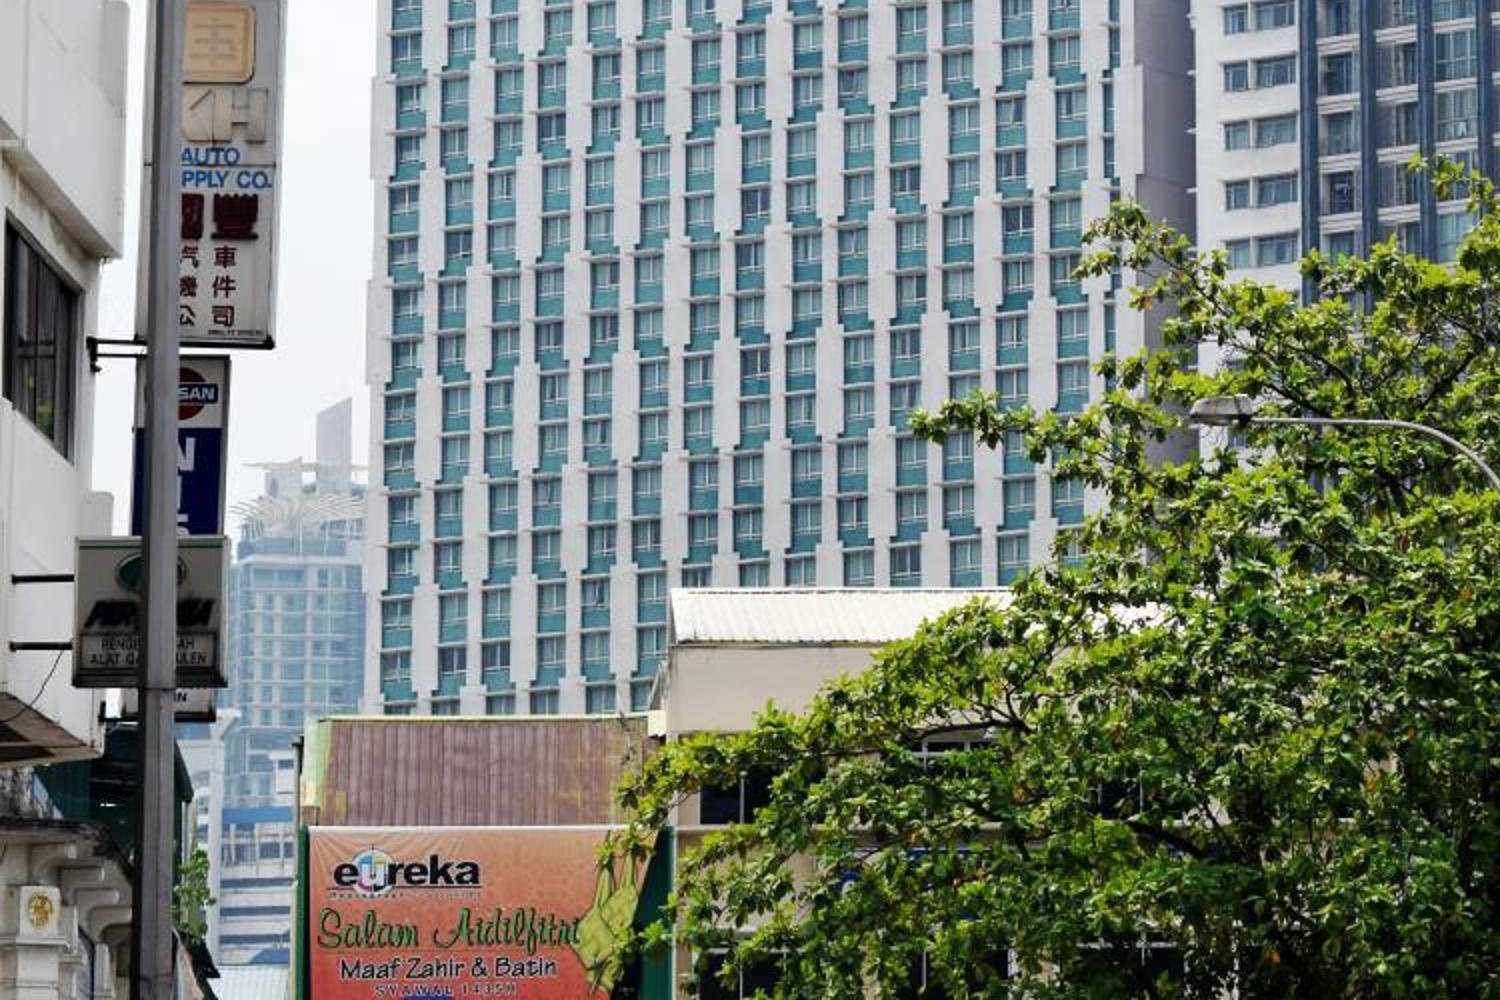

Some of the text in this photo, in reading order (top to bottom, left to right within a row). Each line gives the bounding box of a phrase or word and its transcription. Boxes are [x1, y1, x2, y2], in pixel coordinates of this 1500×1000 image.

[181, 147, 240, 166] AUTO
[181, 171, 272, 188] PPLY CO.
[333, 854, 481, 892] eureka
[318, 907, 419, 949] Salam
[341, 956, 556, 979] Maaf Zahir & Batin
